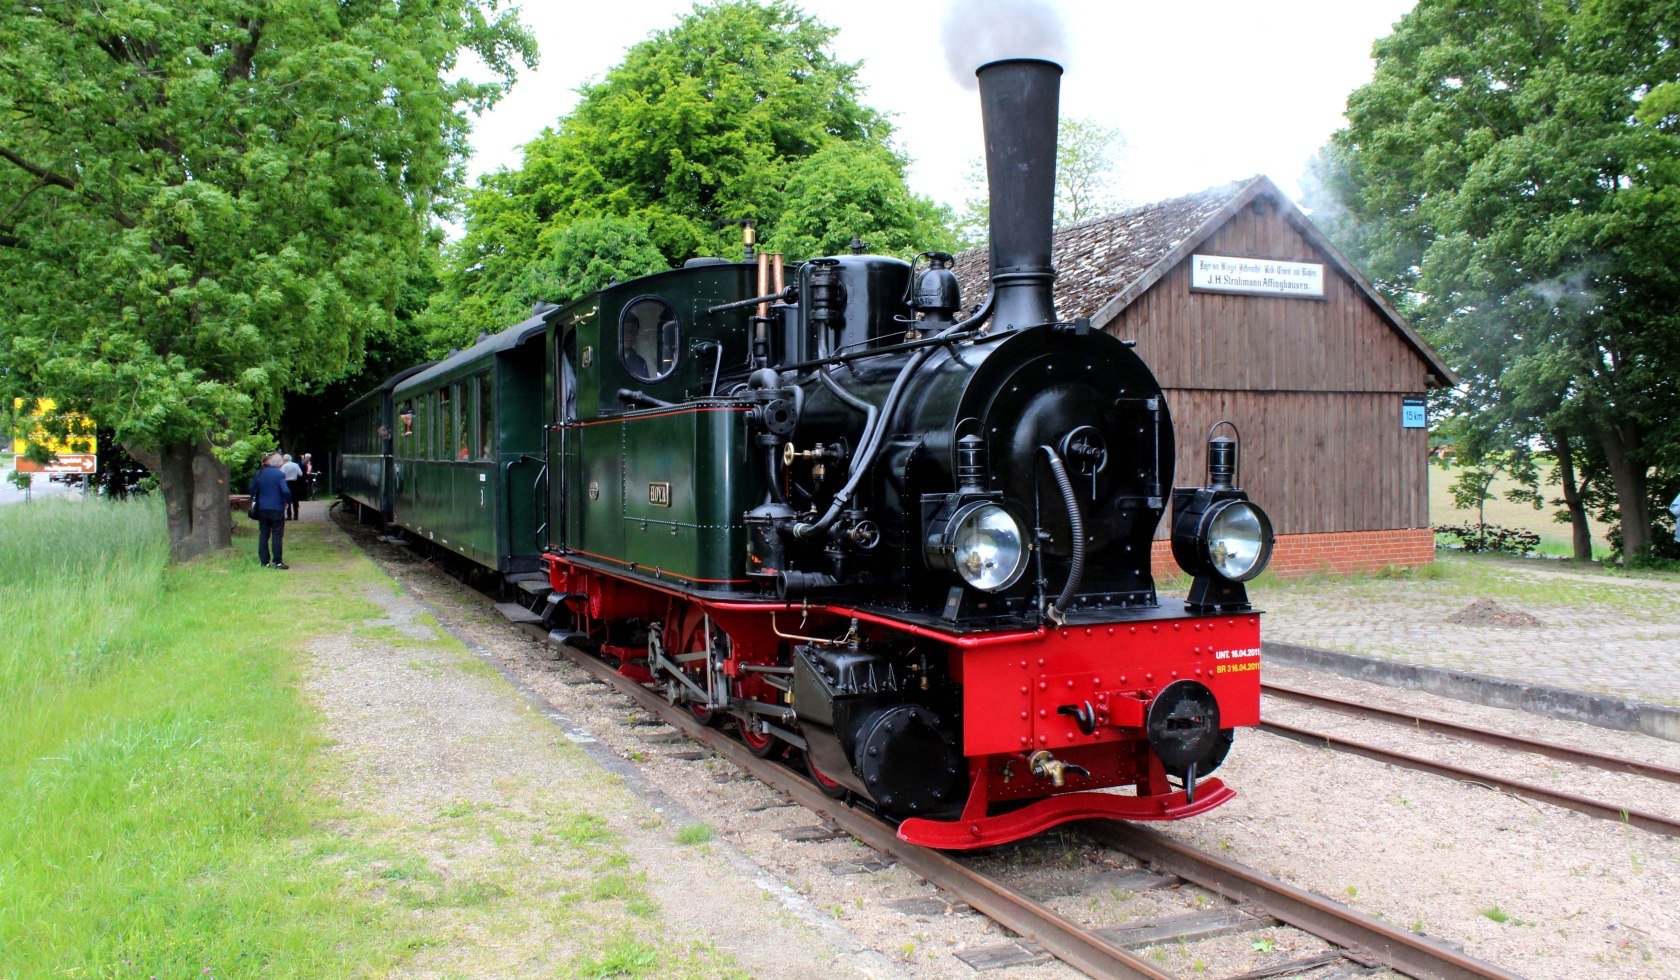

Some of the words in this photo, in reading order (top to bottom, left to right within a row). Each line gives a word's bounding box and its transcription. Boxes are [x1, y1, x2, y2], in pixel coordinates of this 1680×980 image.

[1406, 411, 1413, 421] 15
[1413, 411, 1423, 421] km
[650, 485, 666, 503] HOYA
[1230, 648, 1260, 659] 16.04.2011
[1216, 665, 1226, 674] BR
